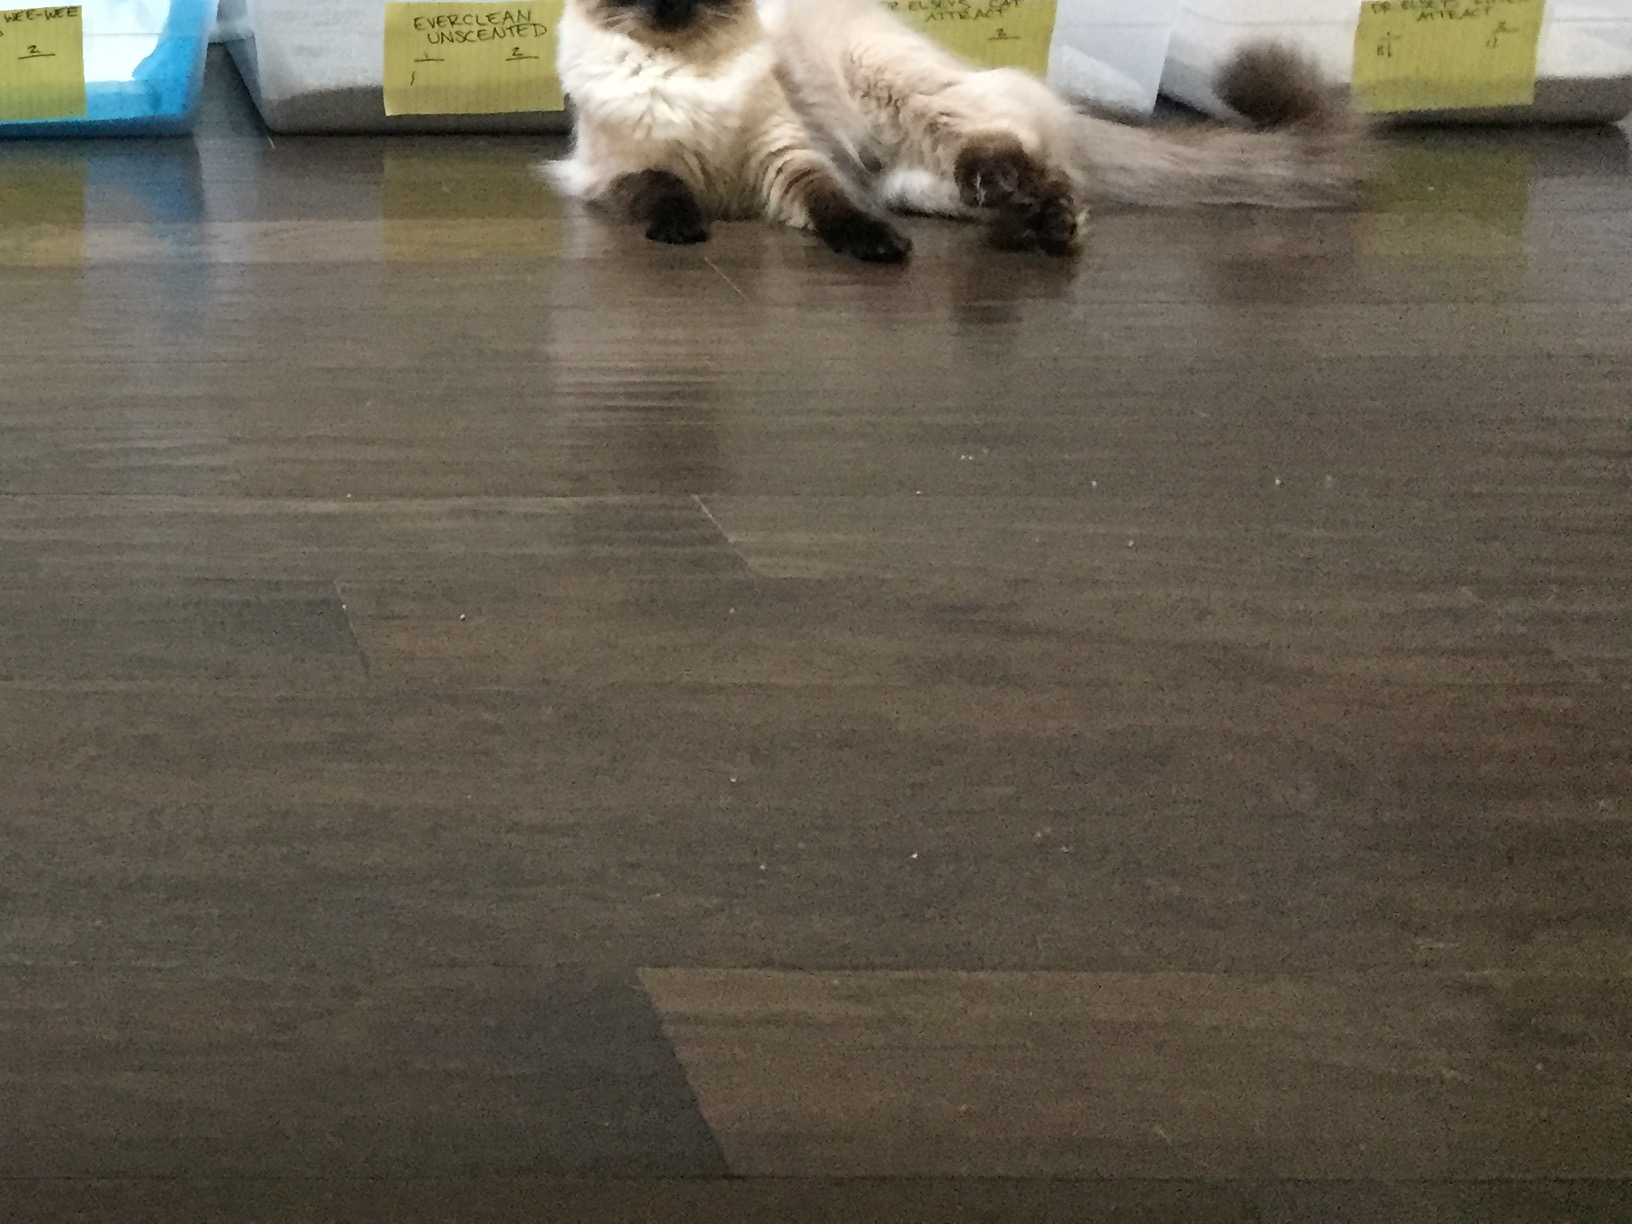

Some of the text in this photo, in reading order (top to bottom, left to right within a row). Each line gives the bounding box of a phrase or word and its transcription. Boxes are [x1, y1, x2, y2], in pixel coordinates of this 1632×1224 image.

[3, 6, 79, 23] WEE-WEE
[413, 9, 533, 31] EVERCLEAN
[925, 7, 1007, 22] ATTRACT
[427, 22, 548, 44] UNSCENTED
